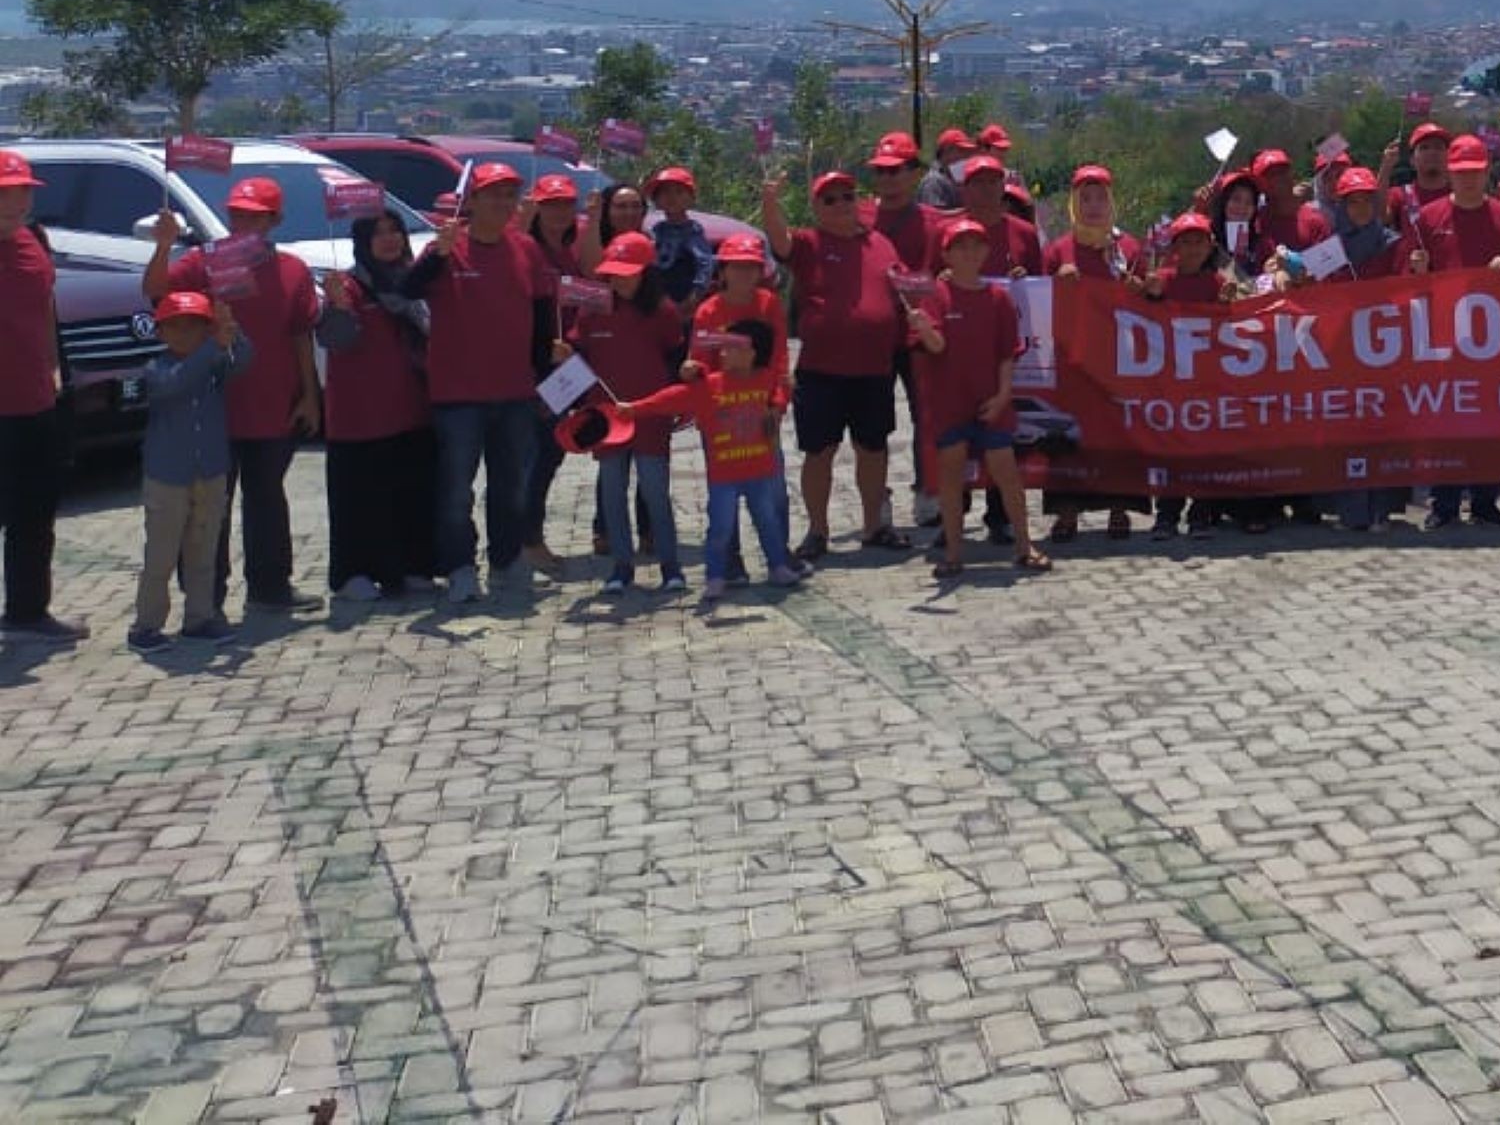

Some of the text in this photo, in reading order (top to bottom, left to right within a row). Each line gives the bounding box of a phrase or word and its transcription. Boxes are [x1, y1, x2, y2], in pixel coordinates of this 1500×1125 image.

[1114, 309, 1329, 380] DFSK
[1113, 387, 1386, 432] TOGETHER
[1402, 379, 1482, 414] WE
